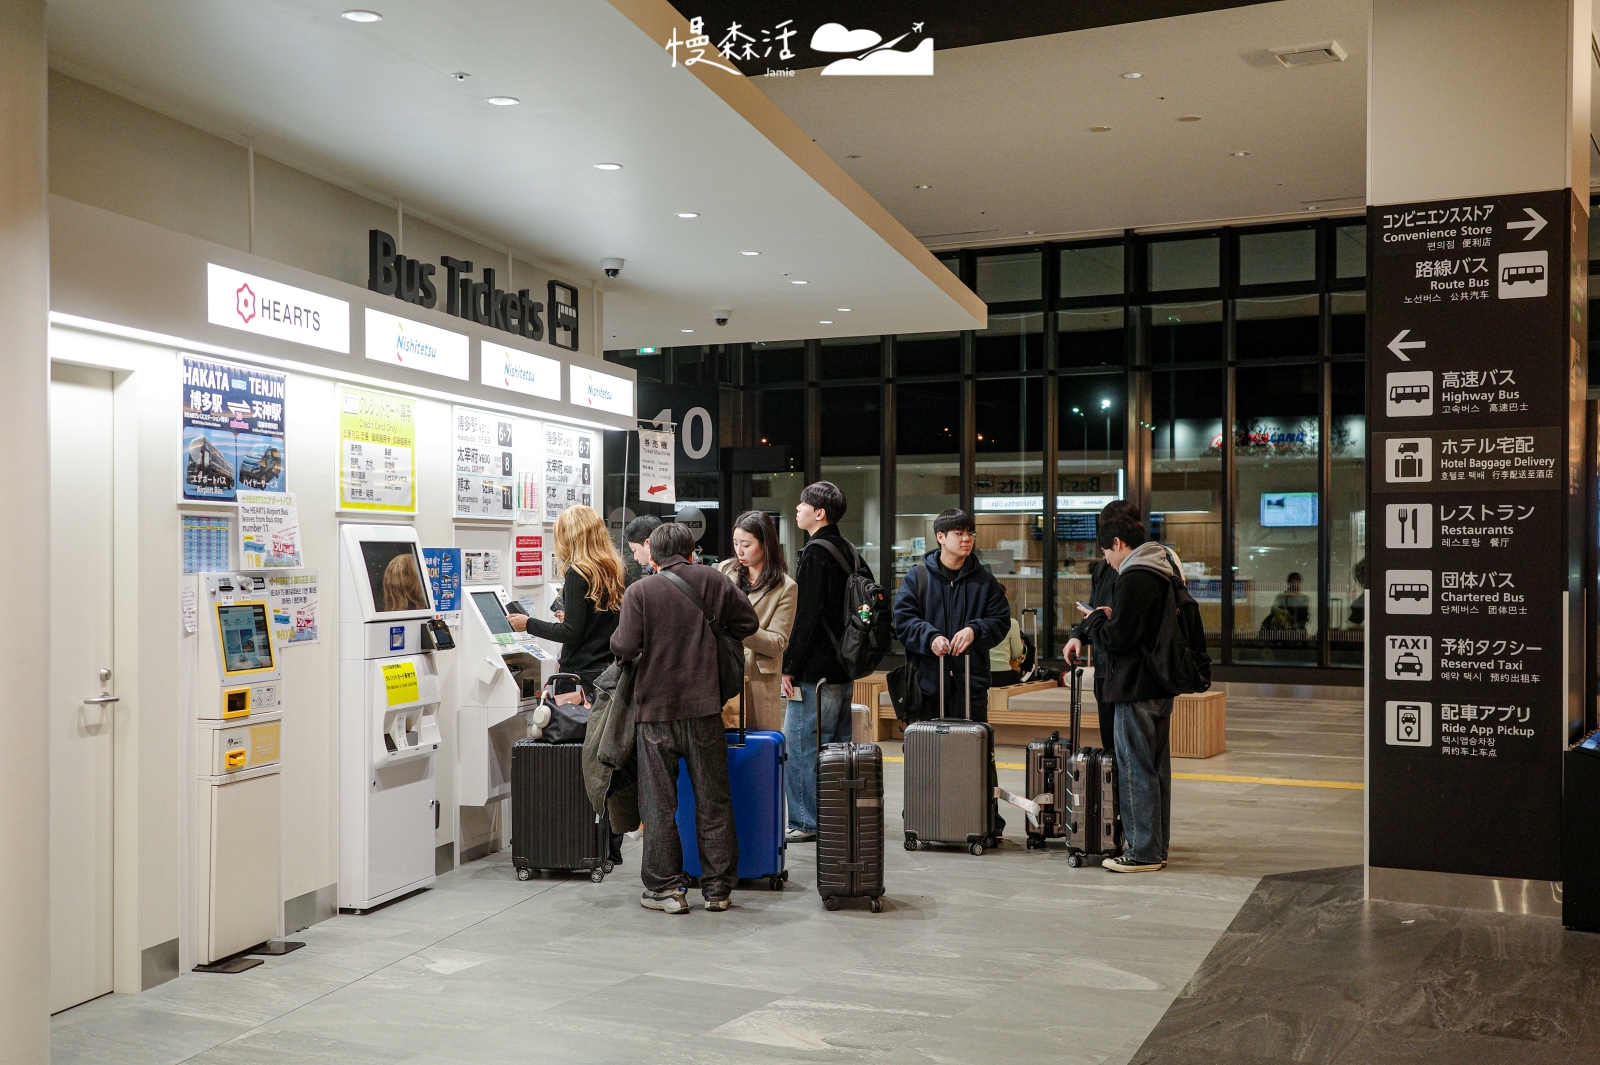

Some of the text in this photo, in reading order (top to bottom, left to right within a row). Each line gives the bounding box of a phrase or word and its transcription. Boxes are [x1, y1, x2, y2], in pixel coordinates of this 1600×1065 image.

[1383, 205, 1494, 229] コンビニエンスストア
[1383, 226, 1492, 243] Convenience Store
[1427, 237, 1492, 251] 편의점 便利店
[1415, 257, 1489, 278] 路線バス
[368, 229, 545, 342] Bus Tickets
[1430, 278, 1490, 291] Route Bus
[1404, 291, 1489, 304] 노선버스 公共汽车
[261, 298, 321, 332] HEARTS
[396, 334, 437, 359] Nishitetsu
[504, 361, 535, 383] Nishitetsu
[1442, 369, 1516, 389] 高速バス
[183, 366, 284, 399] HAKATA TENJIN
[587, 383, 613, 401] Nishitetsu
[1442, 389, 1520, 404] Highway Bus
[190, 389, 282, 421] 博多駅 天神駅
[359, 397, 411, 422] クレジットカード専用
[1442, 402, 1529, 414] 고속버스 高速巴士
[359, 419, 397, 434] Credit Card Only
[457, 414, 478, 432] 博多駅
[546, 430, 563, 446] 博多駅
[1441, 436, 1534, 455] ホテル宅配
[457, 446, 478, 464] 太宰府
[504, 456, 510, 472] 8
[654, 449, 671, 457] Machine
[546, 458, 563, 474] 太宰府
[584, 468, 588, 480] 8
[1441, 457, 1555, 470] Hotel Baggage Delivery
[192, 474, 226, 485] エアポートバス
[1441, 469, 1554, 481] 호텔로 택배 行李配送至酒店
[197, 486, 214, 495] Airport
[458, 477, 470, 492] 熊本
[504, 489, 511, 506] 11
[458, 495, 478, 504] Kumamoto
[242, 506, 250, 514] The
[250, 507, 266, 515] HEARTS
[266, 508, 280, 516] Airport
[1440, 504, 1535, 521] レストラン
[242, 524, 262, 532] number
[1441, 525, 1514, 535] Restaurants
[1441, 538, 1510, 548] 레스토랑 餐厅
[1441, 571, 1515, 589] 団体バス
[1441, 592, 1525, 602] Chartered Bus
[1441, 605, 1528, 615] 단체버스 团体巴士
[1389, 638, 1428, 650] TAXI
[1441, 638, 1542, 656] 予約タクシー
[1441, 659, 1523, 670] Reserved Taxi
[1441, 672, 1541, 683] 예약 택시 预约出租车
[1441, 704, 1530, 723] 配車アプリ
[1442, 724, 1534, 738] Ride App Pickup
[1442, 736, 1495, 746] 택시앱승차장
[1442, 747, 1497, 757] 网约车上车点
